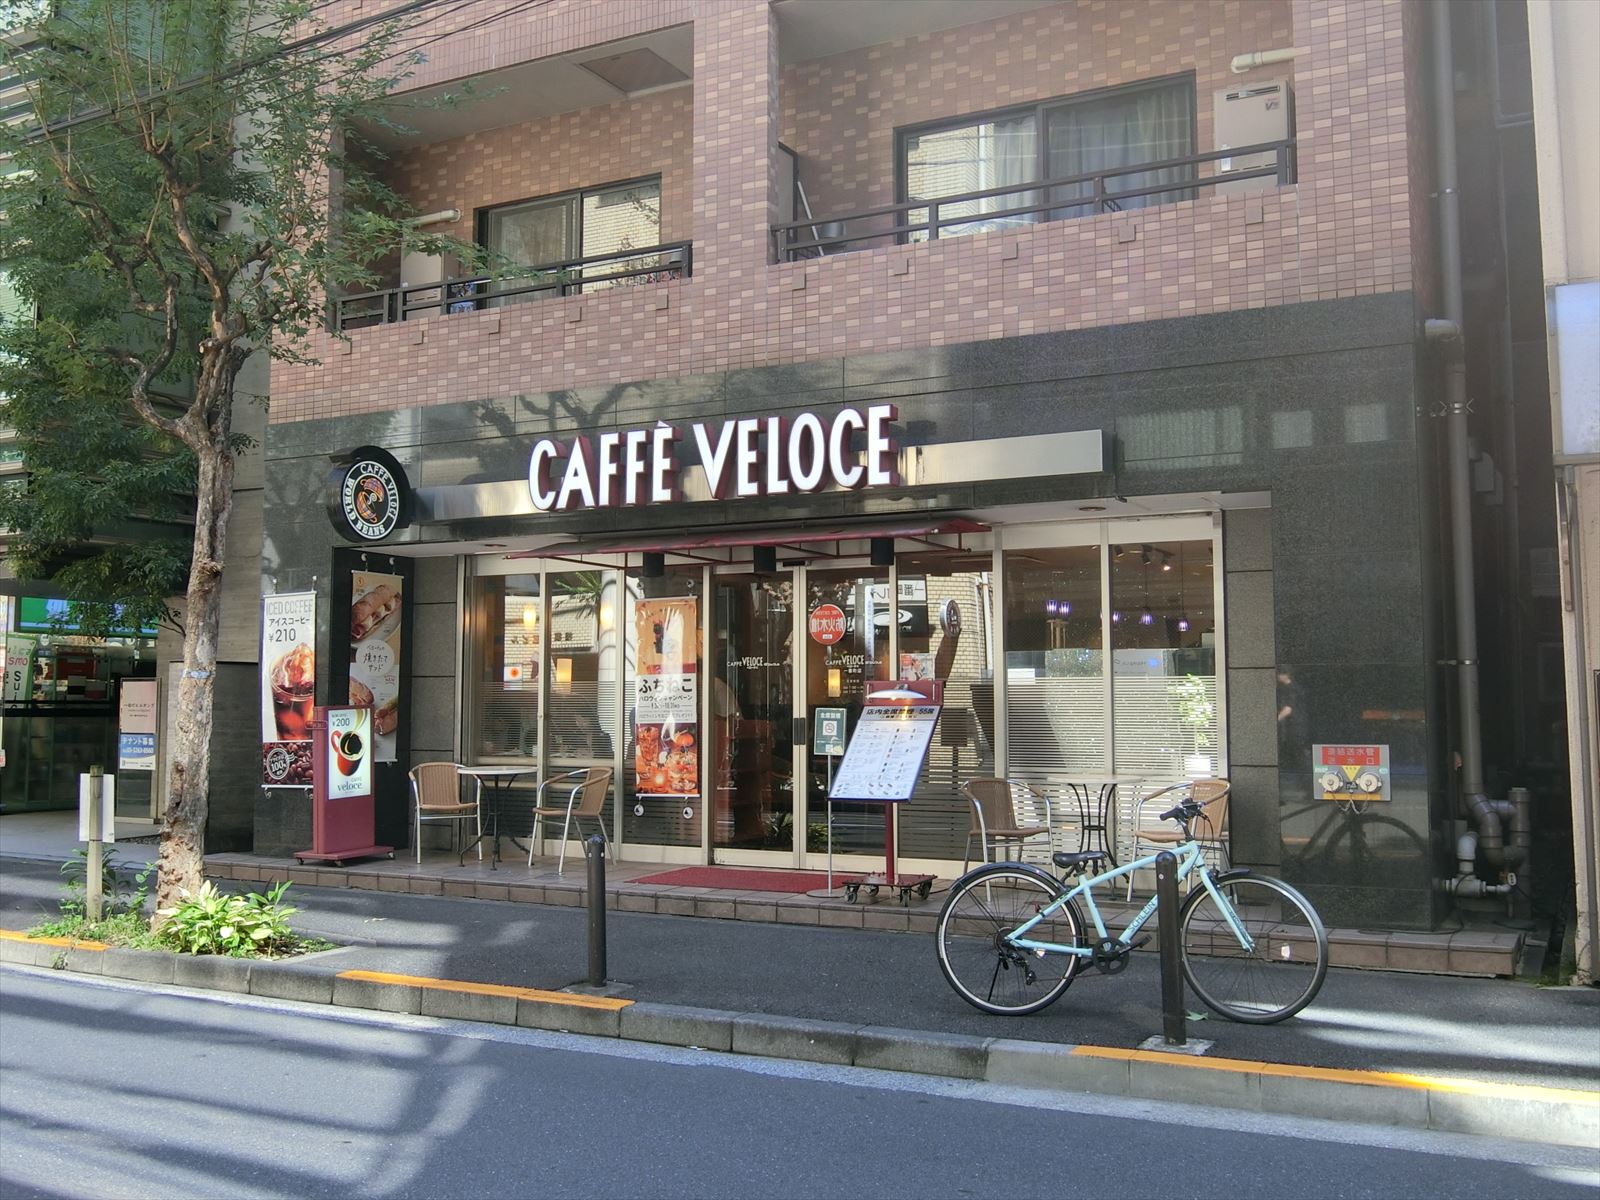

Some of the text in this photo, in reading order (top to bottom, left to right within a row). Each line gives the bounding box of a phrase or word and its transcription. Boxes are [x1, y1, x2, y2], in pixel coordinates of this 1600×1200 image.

[528, 404, 898, 512] CAFFÈ VELOCE
[344, 478, 385, 536] WORLD BEANS
[268, 617, 310, 627] アイスコーヒー
[268, 628, 296, 642] ¥210
[742, 656, 763, 667] VELOCE
[841, 654, 865, 665] VELOCE
[337, 780, 363, 792] veloce
[1128, 901, 1156, 932] SCHLEIN
